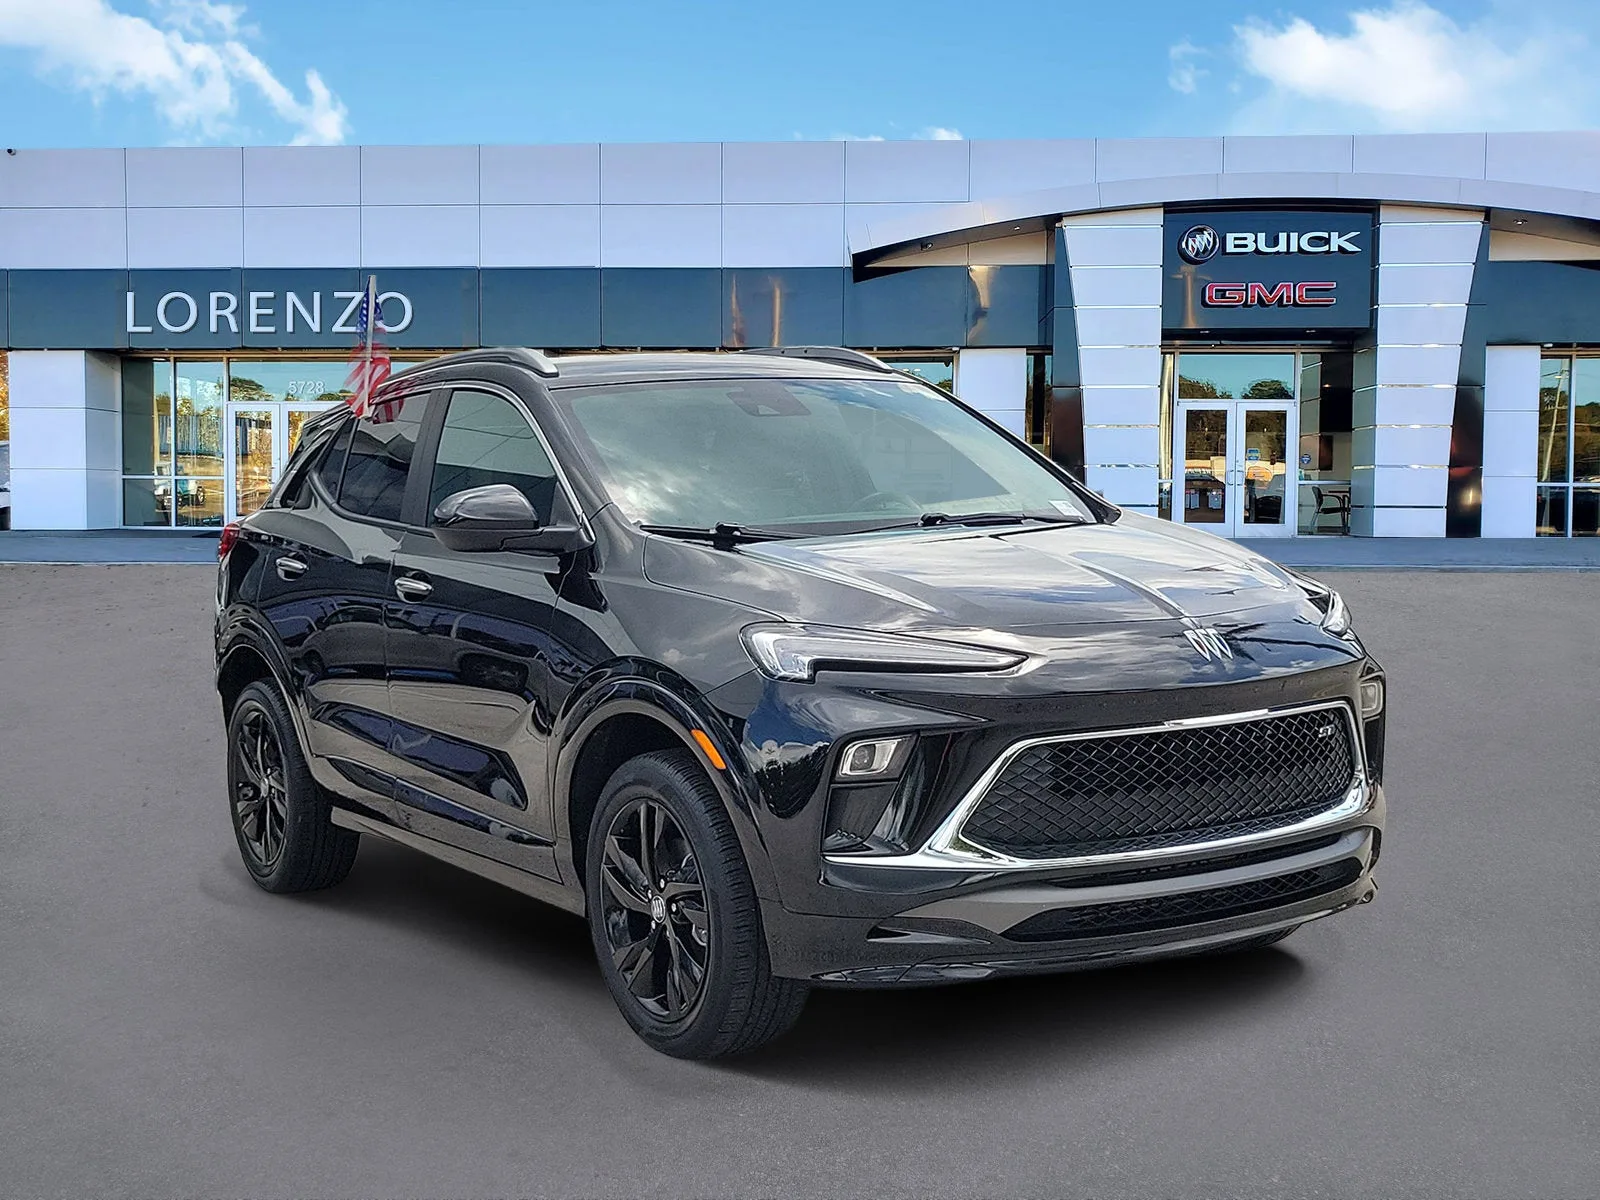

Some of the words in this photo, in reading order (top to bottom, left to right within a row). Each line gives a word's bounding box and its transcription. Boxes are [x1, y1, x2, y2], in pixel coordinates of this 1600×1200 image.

[1225, 231, 1362, 253] BUICK
[1205, 282, 1337, 305] GMC
[126, 291, 413, 333] LORENZO
[288, 381, 325, 394] 5728
